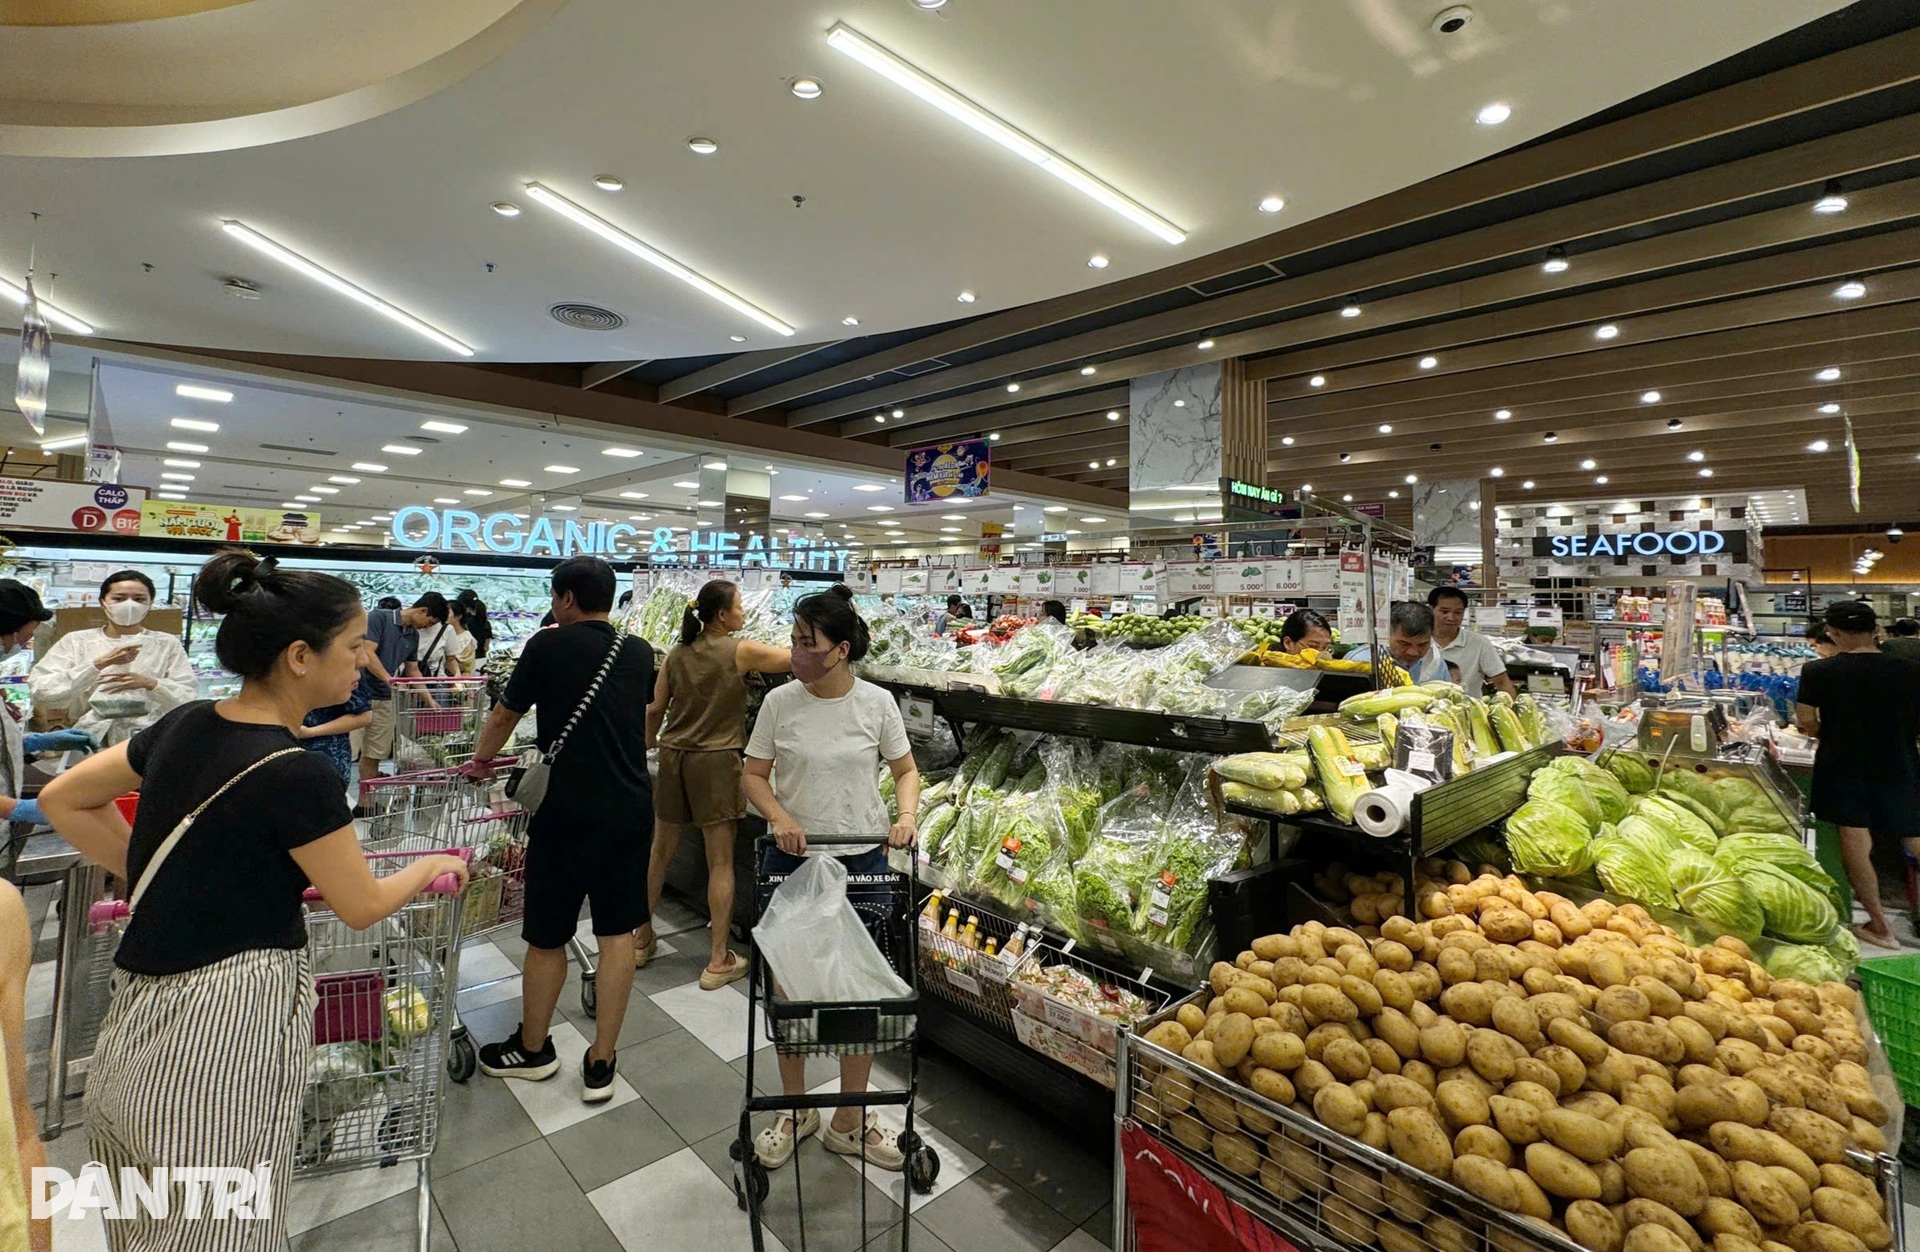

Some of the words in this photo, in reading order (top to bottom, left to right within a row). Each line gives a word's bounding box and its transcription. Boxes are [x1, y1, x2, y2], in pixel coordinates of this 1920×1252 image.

[98, 489, 125, 497] CALO
[1231, 480, 1247, 495] HÔM
[1247, 485, 1260, 498] NAY
[1260, 487, 1270, 501] ĂN
[1277, 493, 1283, 504] ?
[98, 495, 124, 504] THẤP
[83, 514, 98, 528] D
[116, 518, 140, 530] B12
[392, 505, 638, 560] ORGANIC
[649, 527, 679, 562] &
[690, 530, 850, 572] HEALTHY
[1551, 530, 1725, 557] SEAFOOD
[768, 875, 784, 883] XIN
[855, 873, 873, 882] VÀO
